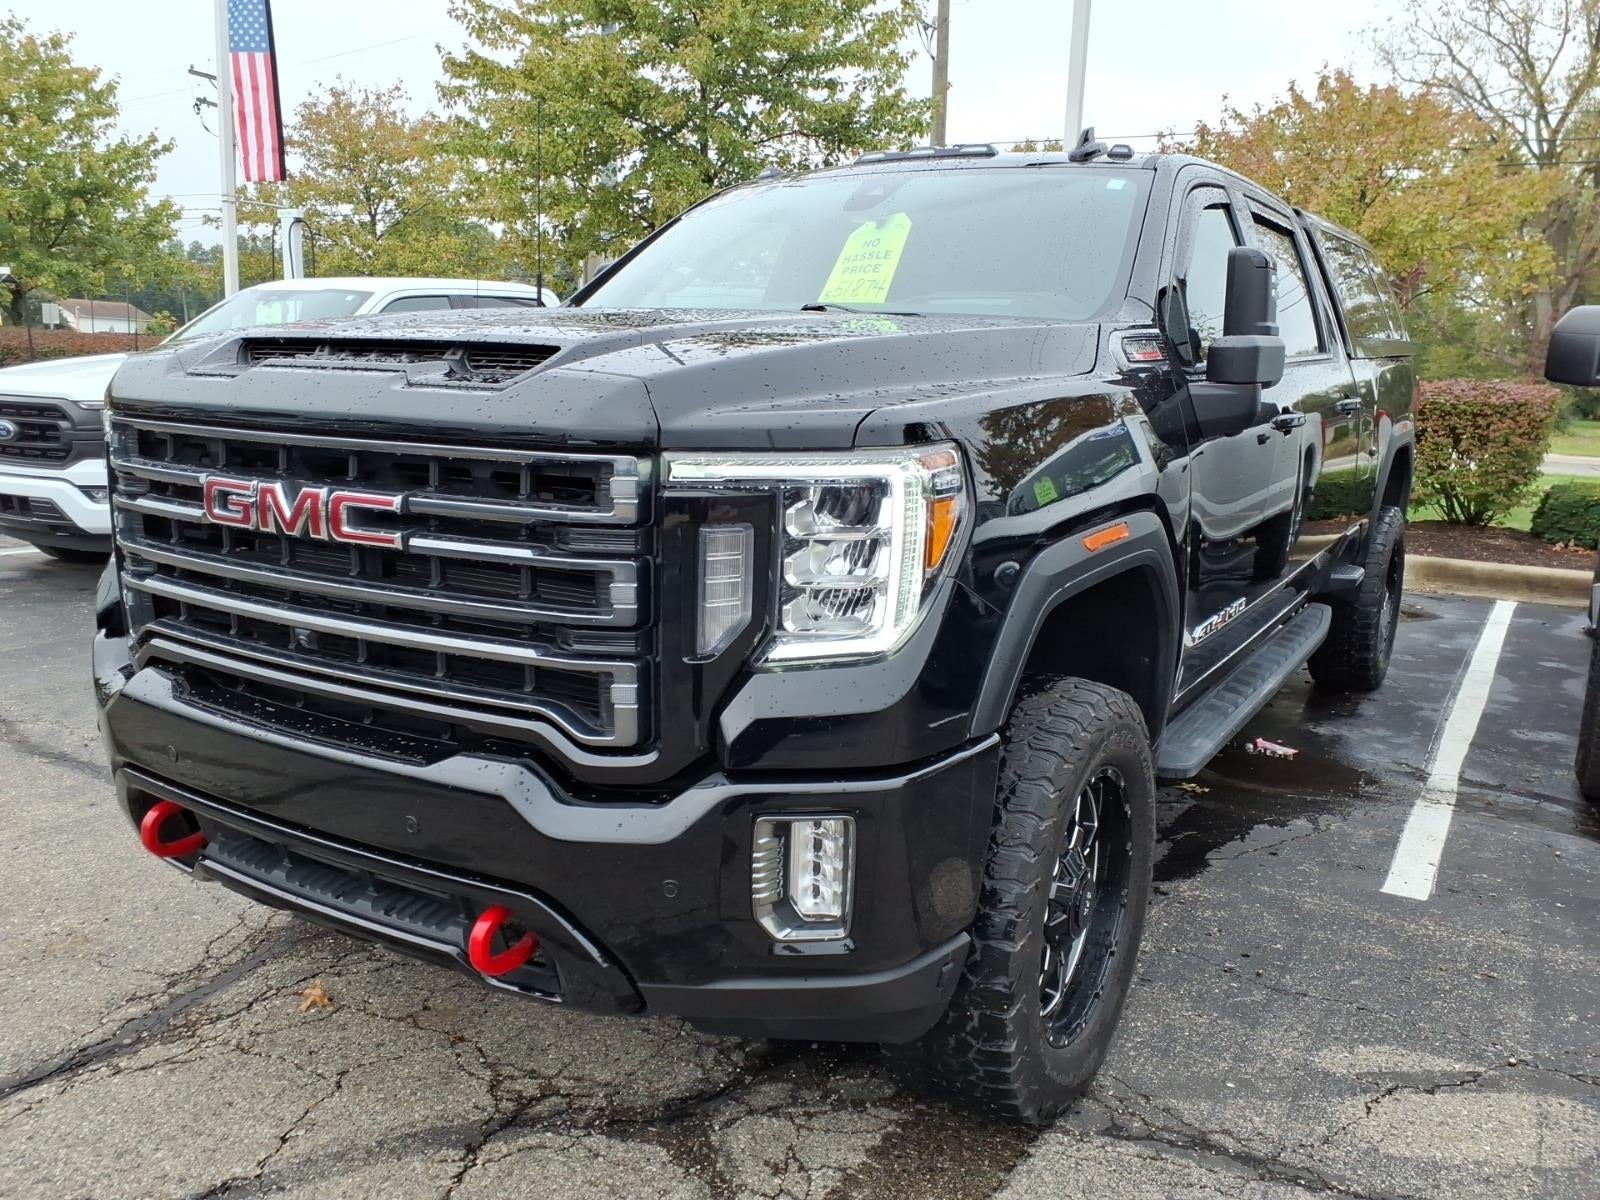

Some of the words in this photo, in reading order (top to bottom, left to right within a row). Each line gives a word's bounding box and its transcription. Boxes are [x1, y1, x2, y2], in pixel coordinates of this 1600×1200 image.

[862, 238, 881, 248] NO
[843, 250, 893, 264] HASSLE
[841, 264, 882, 276] PRICE
[203, 475, 403, 550] GMC
